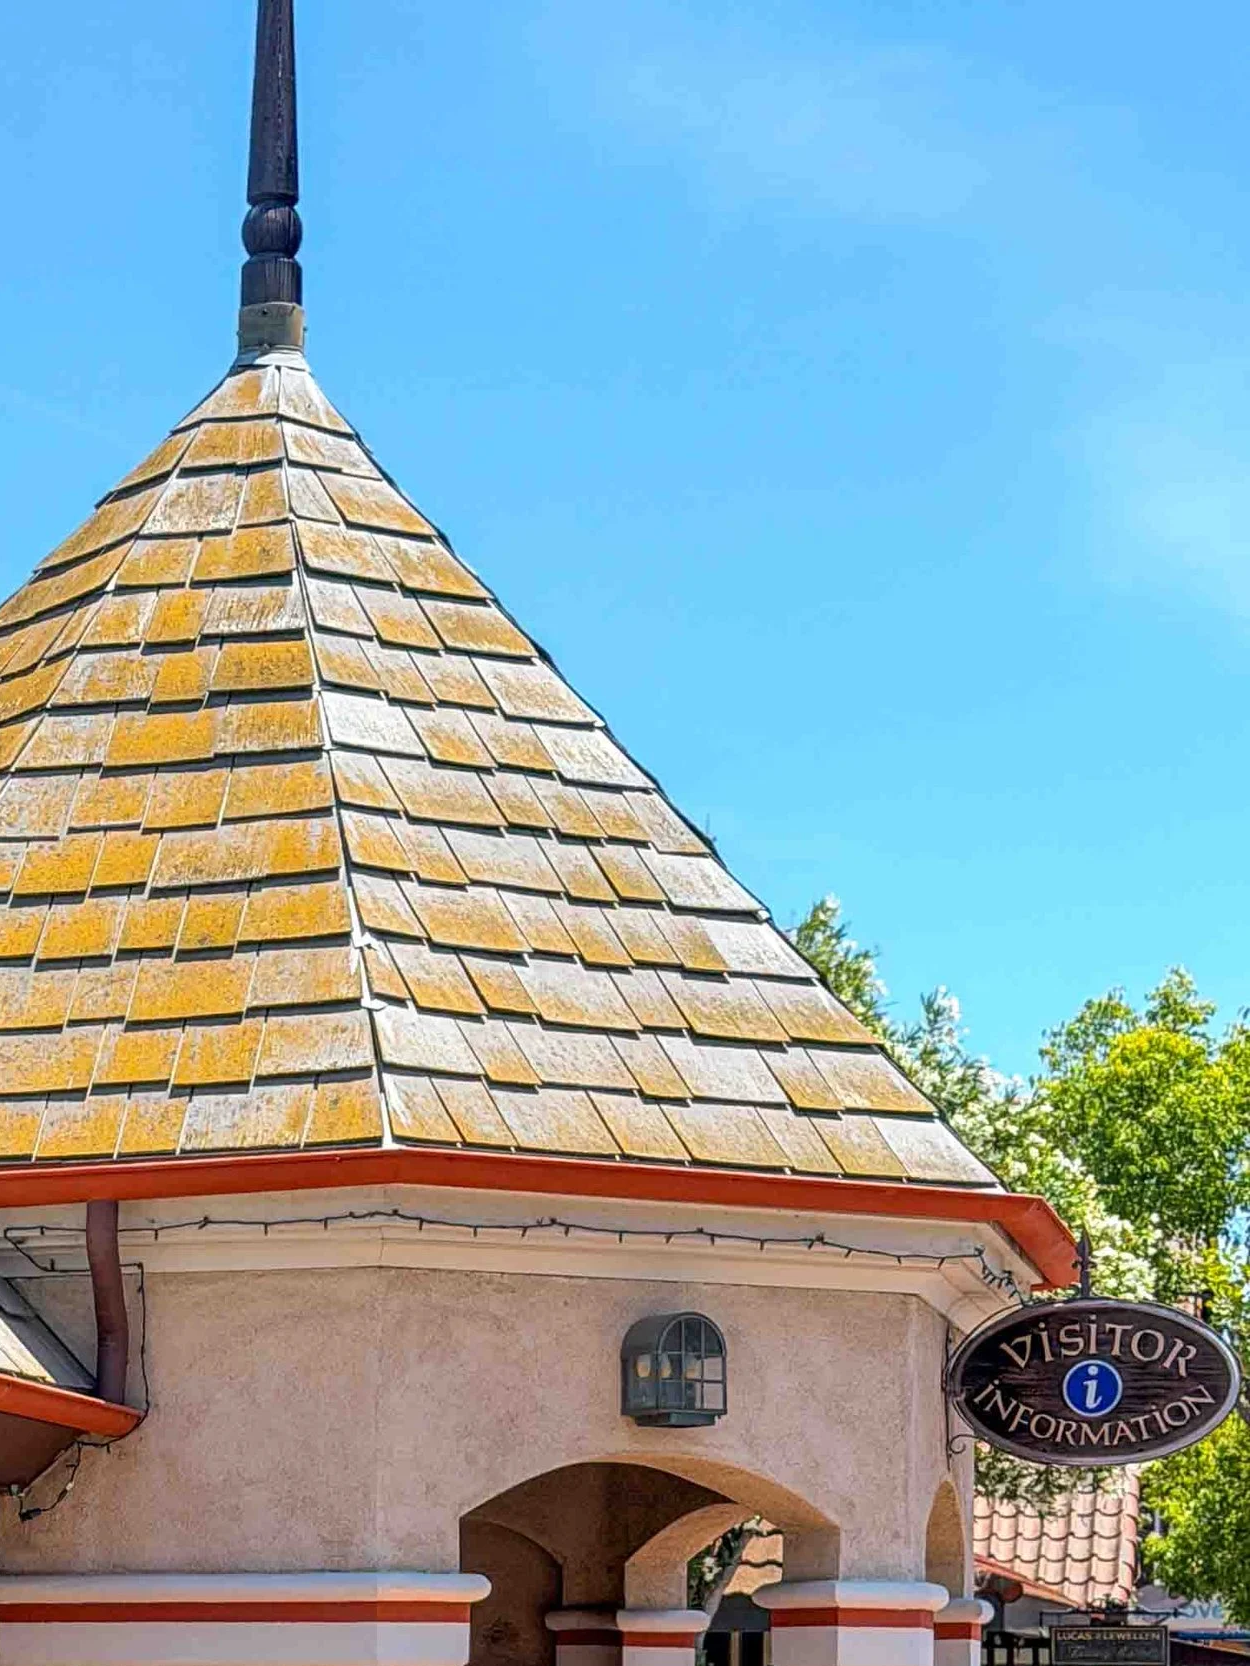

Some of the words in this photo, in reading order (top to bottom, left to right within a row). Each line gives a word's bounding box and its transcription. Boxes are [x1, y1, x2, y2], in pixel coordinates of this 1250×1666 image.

[1000, 1314, 1197, 1378] VISITOR
[973, 1379, 1217, 1447] INFORMATION
[1056, 1631, 1092, 1641] LUCAS
